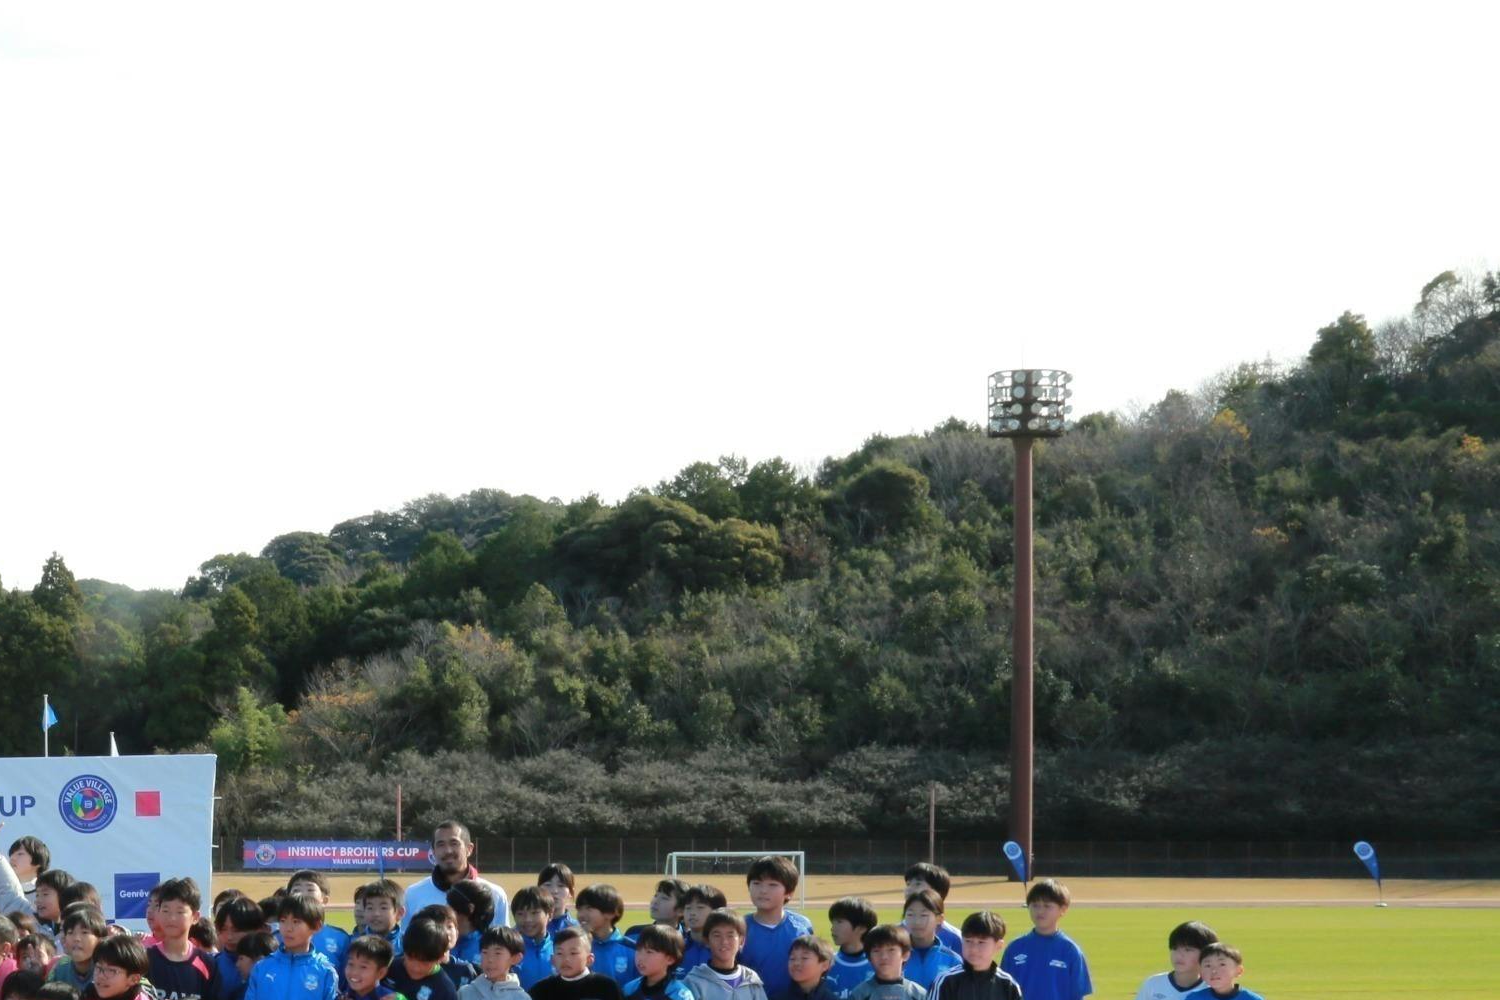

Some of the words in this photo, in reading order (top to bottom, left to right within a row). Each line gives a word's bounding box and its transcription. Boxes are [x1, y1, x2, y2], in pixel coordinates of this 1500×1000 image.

[64, 780, 85, 804] VALUE
[85, 780, 113, 804] VILLAGE
[287, 846, 337, 857] INSTINCT
[396, 847, 419, 857] CUP
